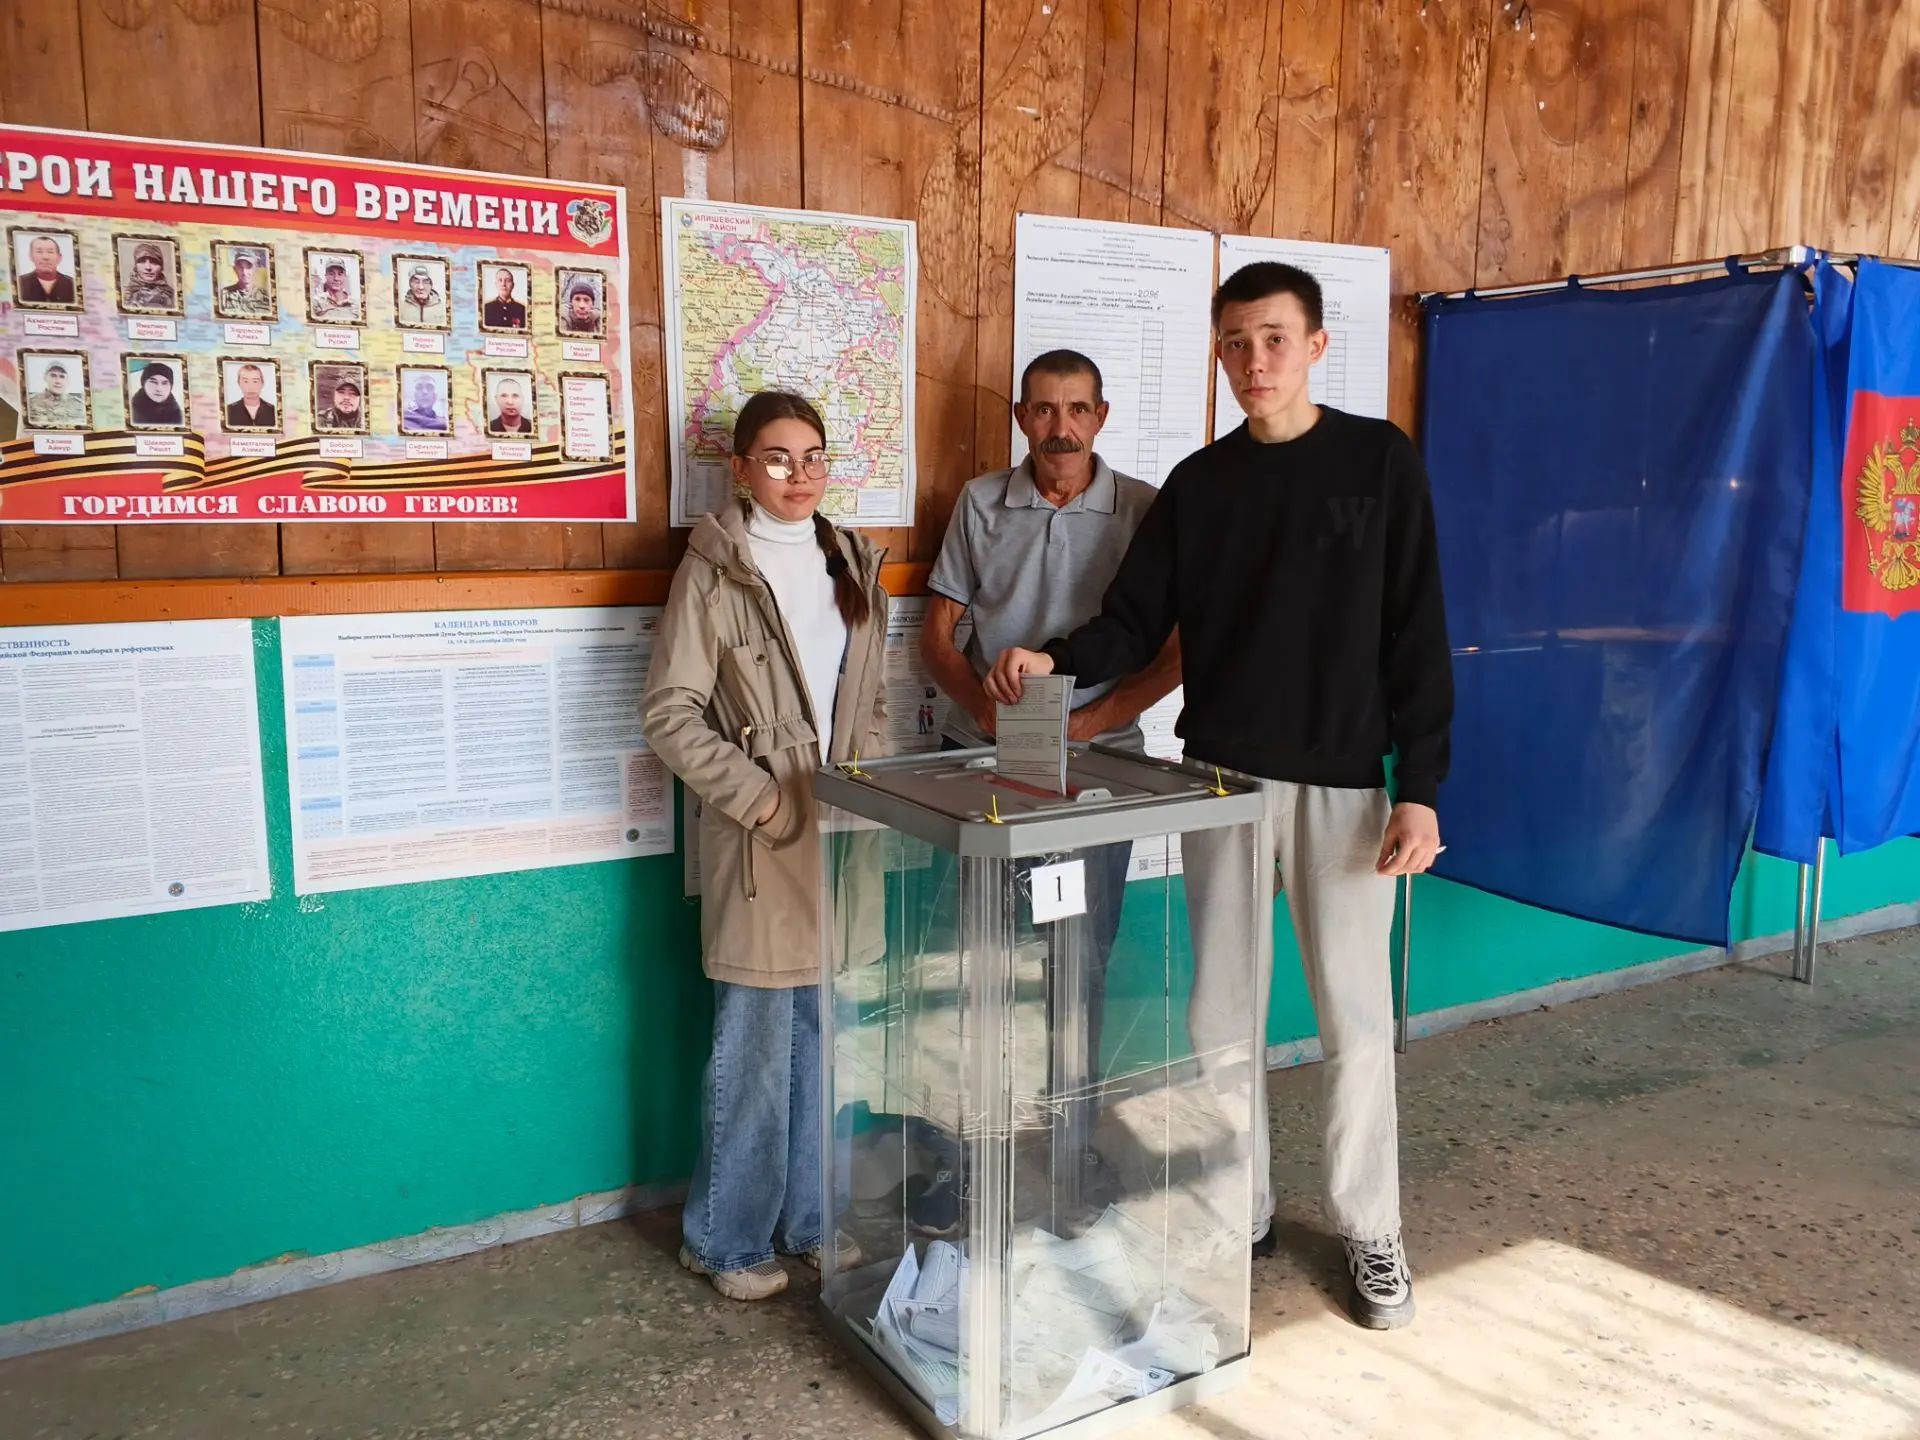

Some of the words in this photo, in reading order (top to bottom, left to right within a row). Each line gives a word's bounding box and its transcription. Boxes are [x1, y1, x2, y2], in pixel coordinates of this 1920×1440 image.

[0, 150, 113, 198] РОИ
[132, 163, 336, 216] НАШЕГО
[353, 182, 560, 236] ВРЕМЕНИ
[694, 213, 751, 225] ИЛИШЕВСКИЙ
[709, 223, 737, 232] РАЙОН
[63, 496, 238, 518] ГОРДИМСЯ
[257, 495, 387, 515] СЛАВОЮ
[404, 495, 518, 515] ГЕРОЕВ!
[433, 620, 491, 630] КАЛЕНДАРЬ
[493, 618, 539, 628] ВЫБОРОВ
[1055, 875, 1063, 903] 1
